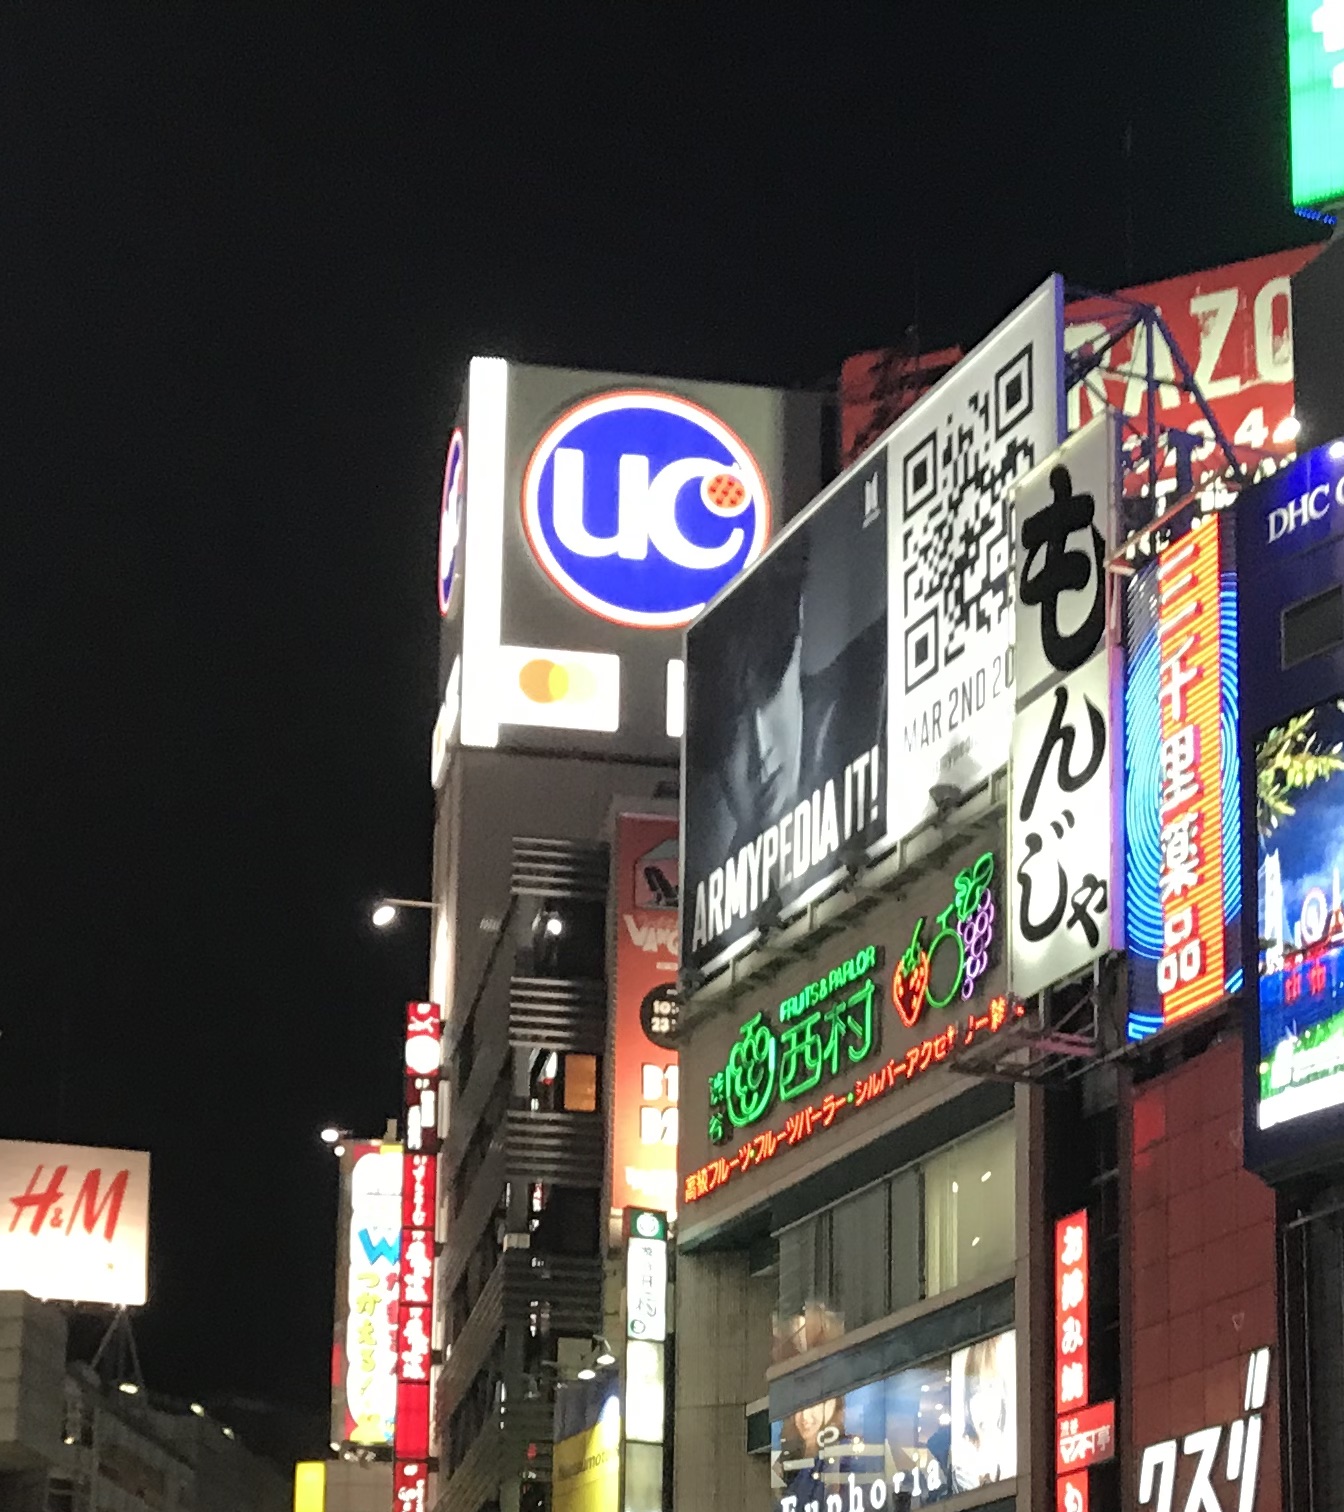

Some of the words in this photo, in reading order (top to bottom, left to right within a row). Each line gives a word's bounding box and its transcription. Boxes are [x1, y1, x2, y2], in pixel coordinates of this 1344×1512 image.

[1267, 484, 1330, 542] DHC
[904, 700, 942, 752] MAR
[948, 667, 986, 732] 2ND
[1018, 463, 1109, 950] もんじゃ
[1157, 544, 1203, 994] 三千里薬品
[692, 784, 840, 952] ARMYPEDIA
[843, 743, 882, 843] IT!
[779, 978, 875, 1101] 西村
[708, 1072, 724, 1142] 渋谷
[9, 1163, 130, 1242] H&M
